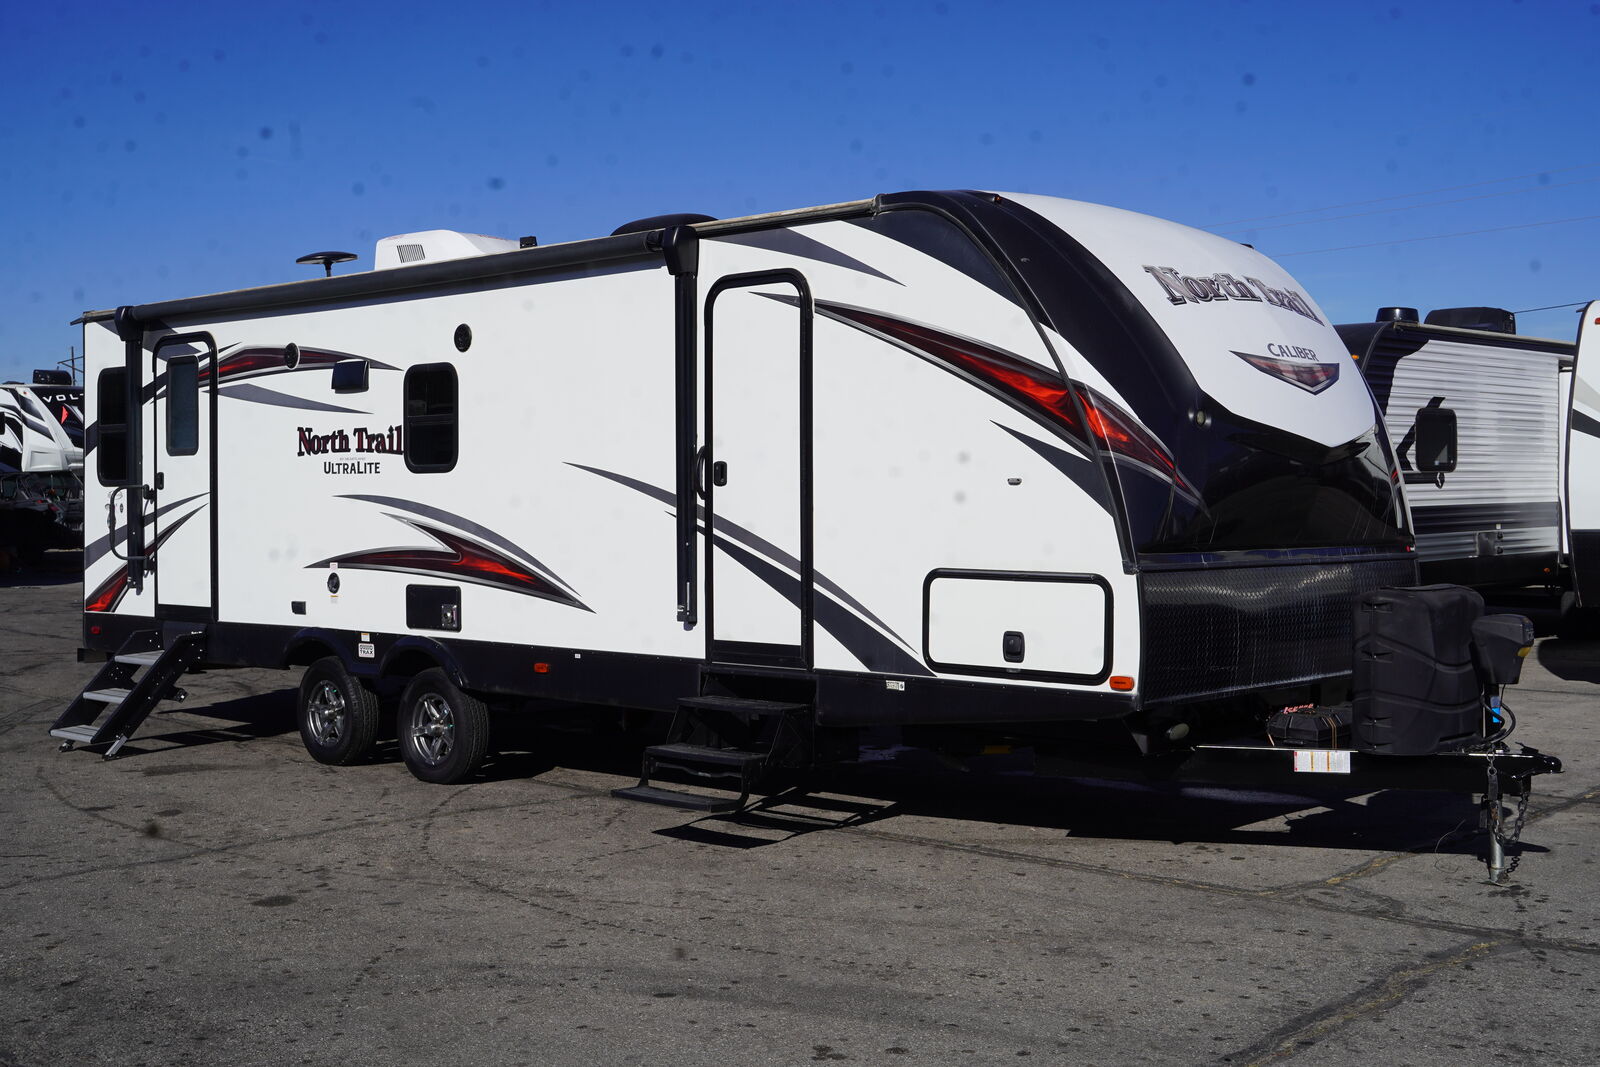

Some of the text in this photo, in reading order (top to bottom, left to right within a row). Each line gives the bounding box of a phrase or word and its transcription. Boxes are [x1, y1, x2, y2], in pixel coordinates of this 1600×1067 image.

[1142, 264, 1325, 327] North Trail
[1267, 343, 1319, 361] CALIBER
[42, 393, 84, 403] VOL
[297, 425, 404, 456] North Trail
